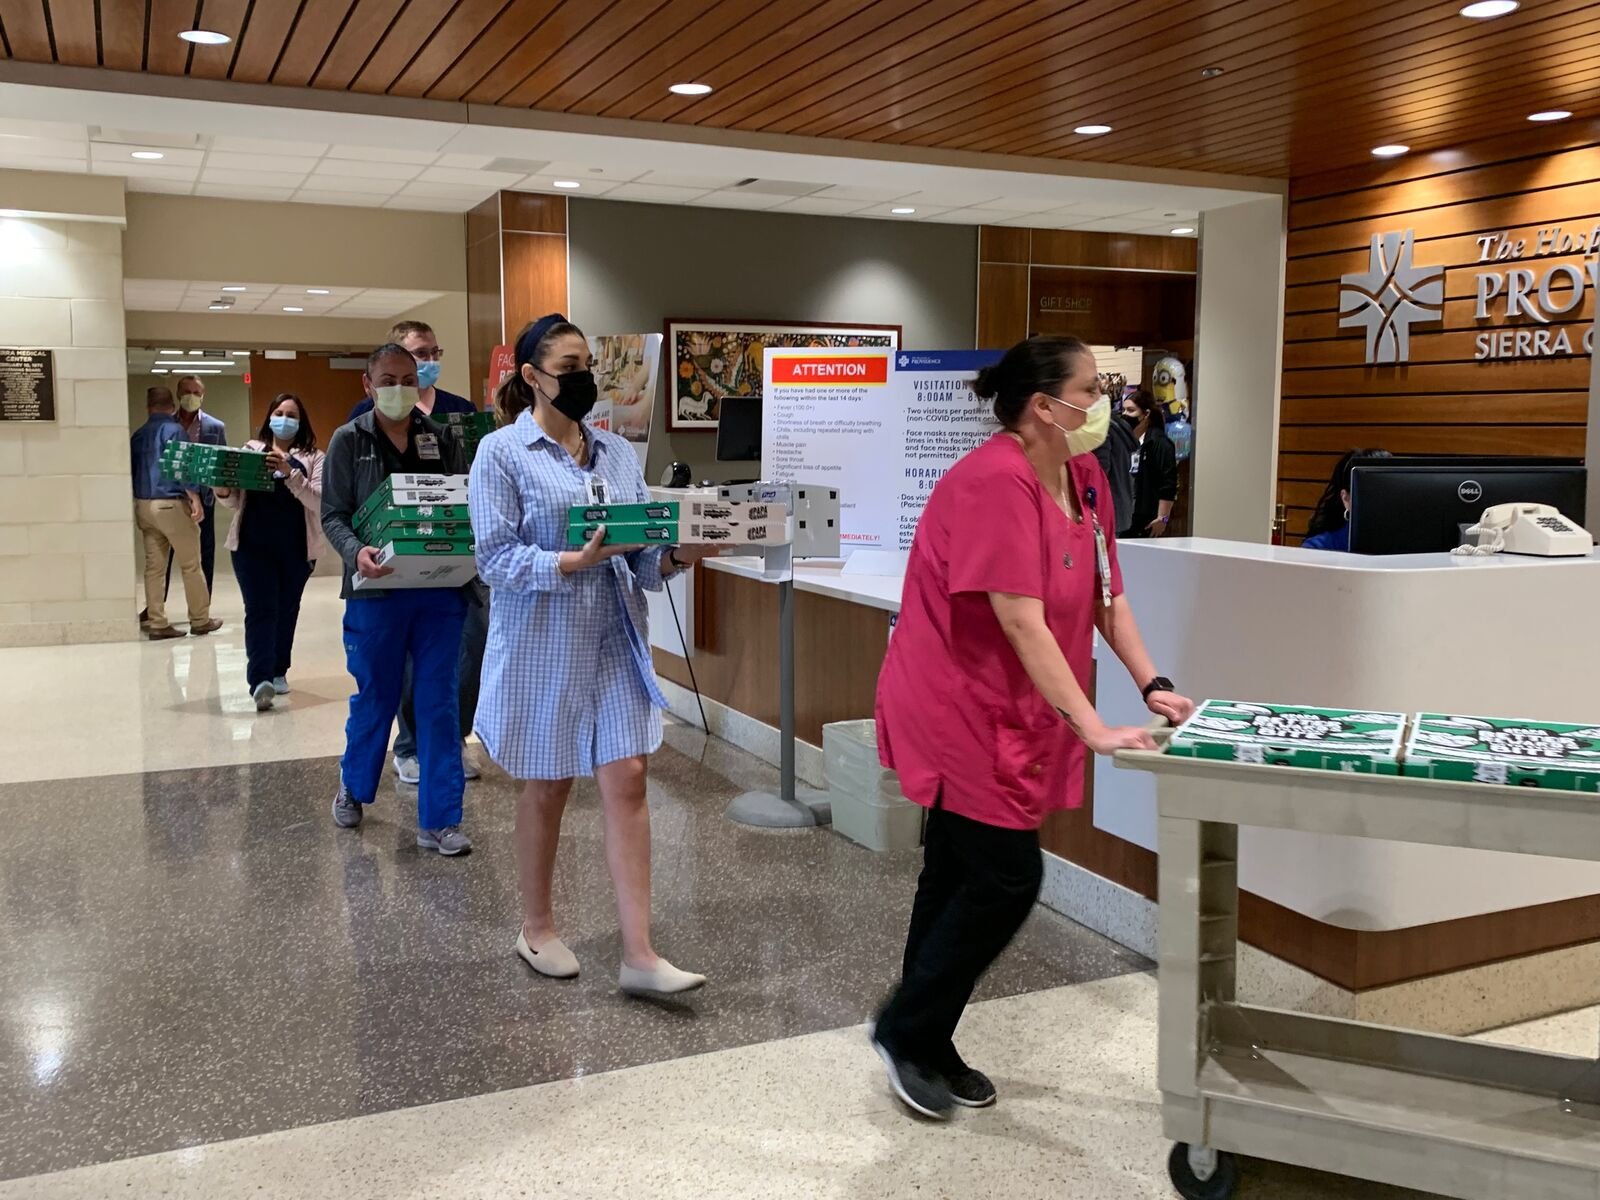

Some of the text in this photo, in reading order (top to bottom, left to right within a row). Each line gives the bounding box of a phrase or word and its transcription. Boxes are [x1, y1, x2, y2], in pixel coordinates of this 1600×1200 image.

[1477, 230, 1526, 261] The
[1040, 296, 1092, 309] GIFT SHOP
[1474, 328, 1573, 360] SIERRA
[792, 363, 866, 376] ATTENTION
[913, 380, 968, 390] VISITATION
[917, 392, 953, 402] 8:00AM
[951, 415, 981, 423] patients
[961, 430, 991, 438] required
[950, 437, 976, 445] facility
[919, 452, 958, 460] permitted)
